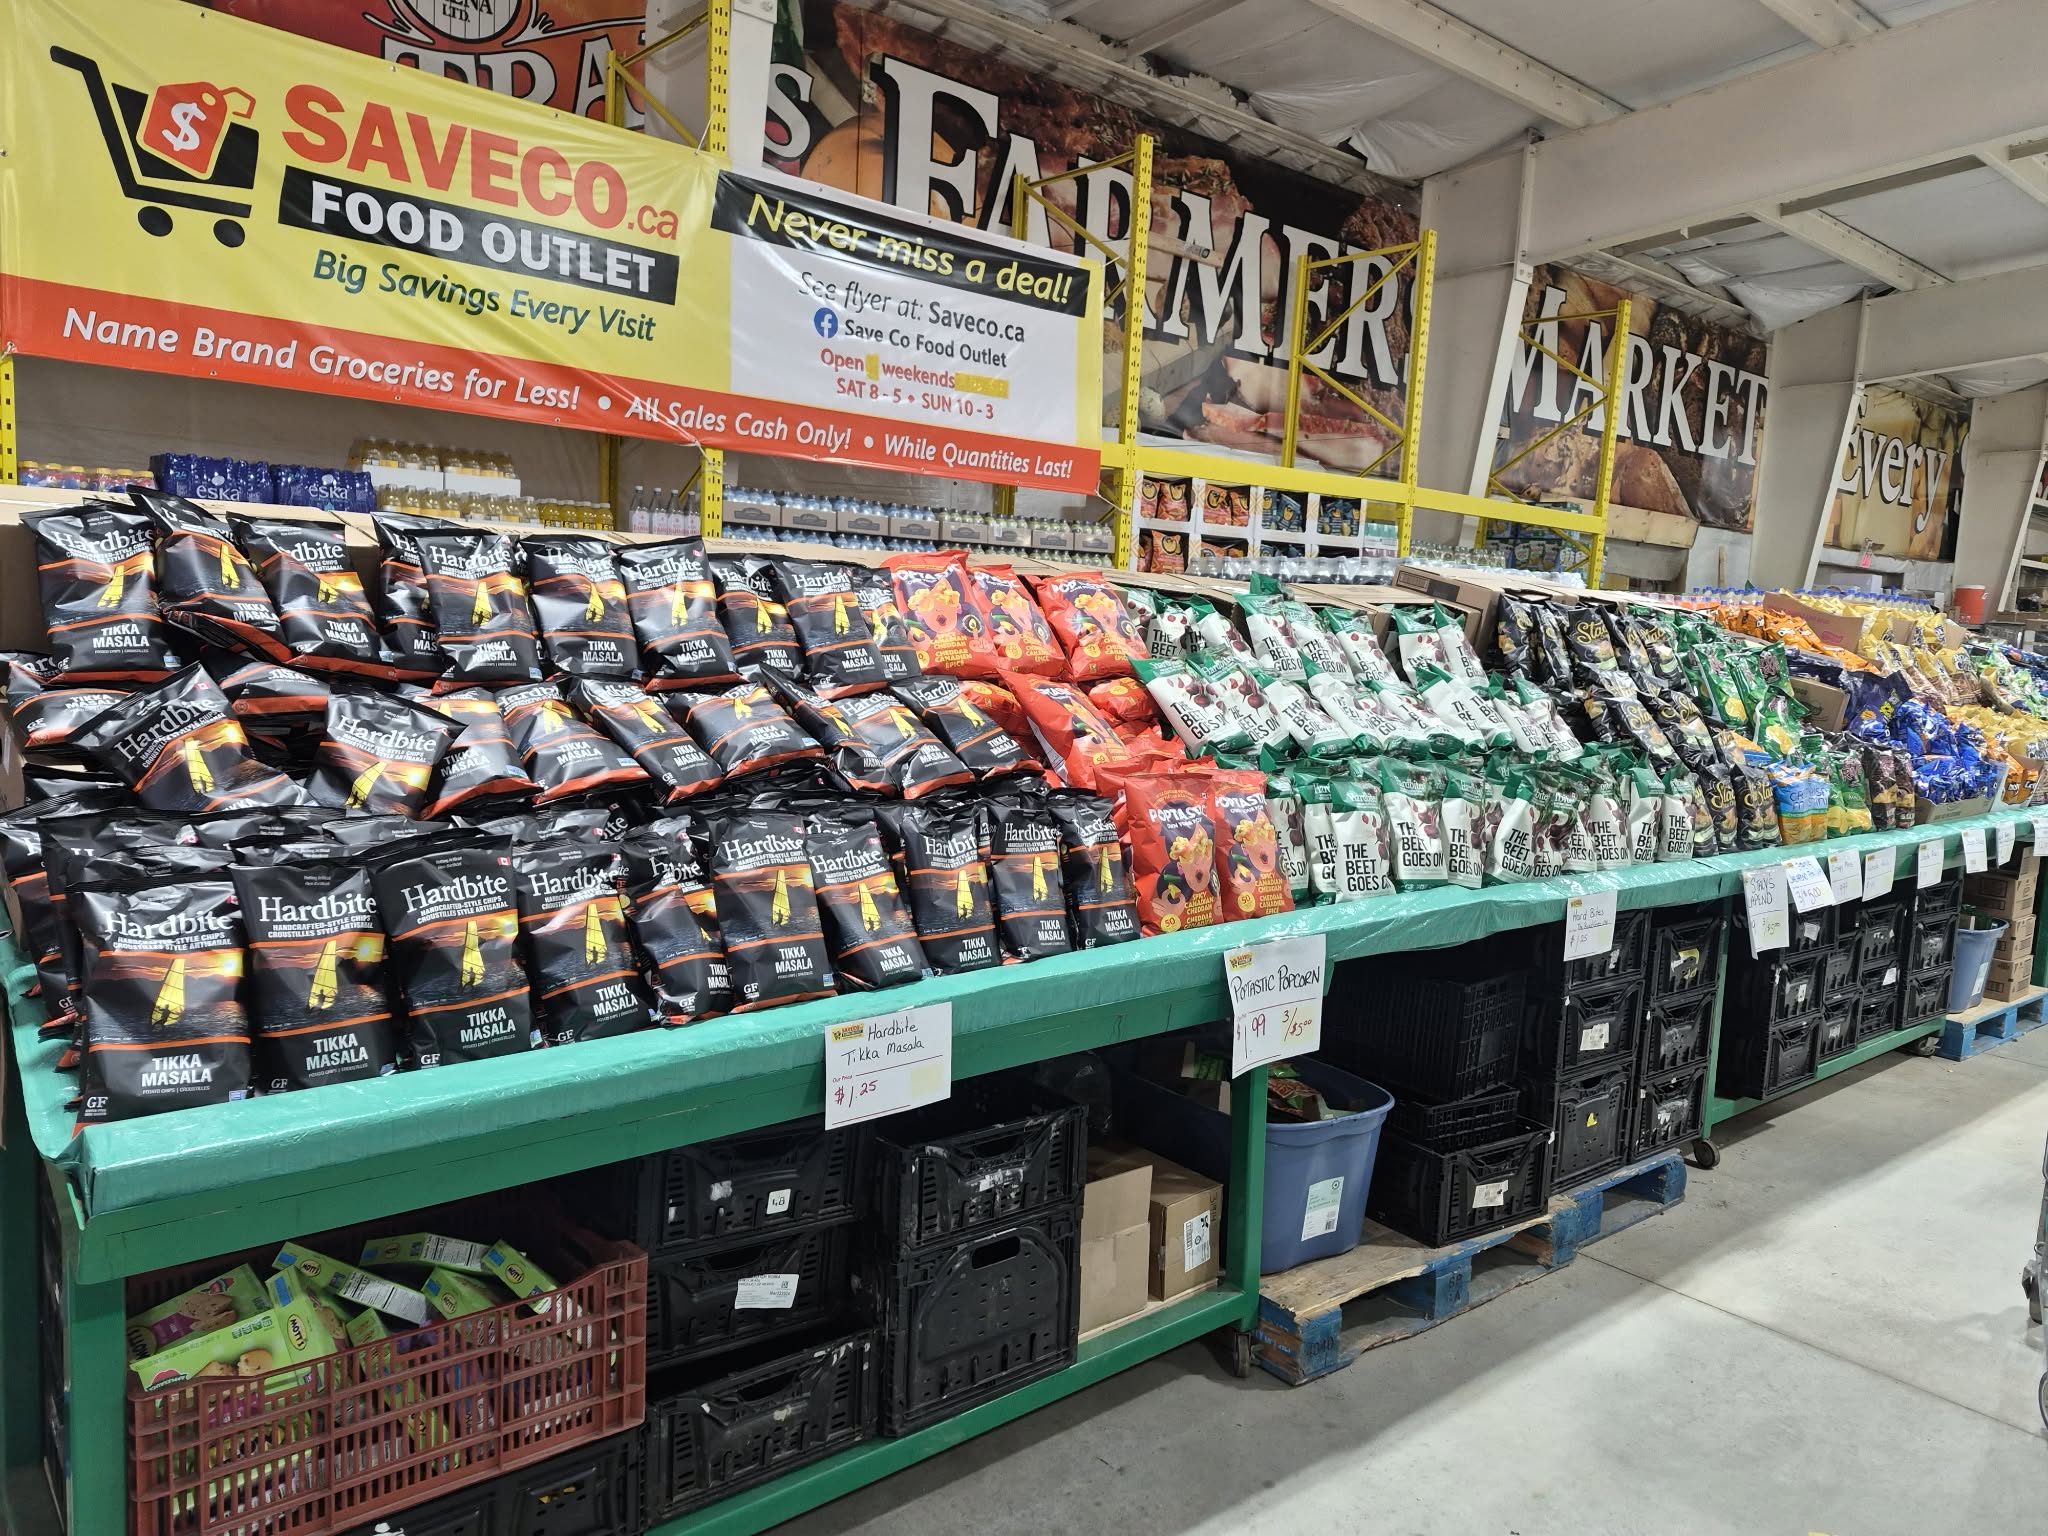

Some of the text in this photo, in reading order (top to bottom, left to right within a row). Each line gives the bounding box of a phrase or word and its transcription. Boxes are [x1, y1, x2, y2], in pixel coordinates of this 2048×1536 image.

[442, 3, 471, 23] LTD.
[311, 180, 655, 293] FOOD OUTLET
[747, 193, 1073, 304] Never miss a deal!
[314, 249, 656, 341] Big Savings Every Visit
[798, 271, 1025, 342] See flyer at: Saveco.ca
[845, 319, 1007, 368] Save Co Food Outlet
[820, 348, 955, 389] Open weekends
[1506, 285, 1769, 466] MARKET
[62, 308, 1072, 478] Name Brand Groceries for Less! All Sales Cash Only! While Quantities Last!
[837, 378, 993, 419] SAT 8 5 SUN 10 3
[51, 529, 155, 554] Hardbite
[101, 623, 140, 636] TIKKA
[1153, 629, 1173, 643] THE
[93, 636, 149, 648] MASALA
[588, 641, 617, 651] TIKKA
[680, 639, 708, 651] TIKKA
[1151, 642, 1177, 656] BEET
[583, 651, 624, 662] MASALA
[677, 648, 716, 663] MASALA
[765, 650, 787, 658] TIKKA
[844, 648, 868, 659] TIKKA
[842, 656, 874, 668] MASALA
[114, 698, 219, 762] Hardbite
[335, 715, 438, 753] Hardbite
[749, 729, 788, 746] MASALA
[751, 725, 778, 735] TIKKA
[672, 744, 697, 755] TIKKA
[987, 735, 1009, 748] TIKKA
[557, 748, 602, 766] MASALA
[674, 753, 706, 767] MASALA
[440, 755, 490, 777] MASALA
[1592, 821, 1611, 834] THE
[1669, 815, 1686, 828] THE
[1509, 828, 1529, 846] THE
[1594, 834, 1616, 847] BEET
[1669, 828, 1689, 841] BEET
[722, 835, 803, 862] Hardbite
[1343, 844, 1367, 859] THE
[1504, 842, 1530, 861] BEET
[1596, 848, 1619, 860] GOES
[1668, 841, 1686, 853] GOES
[809, 849, 884, 874] Hardbite
[1346, 859, 1376, 875] BEET
[1403, 853, 1443, 867] GOES ON
[1449, 859, 1483, 876] GOES ON
[1502, 856, 1526, 875] GOES
[1347, 876, 1380, 892] GOES
[400, 875, 510, 913] Hardbite
[1242, 895, 1251, 904] 50
[258, 893, 376, 922] Hardbite
[1106, 909, 1128, 921] TIKKA
[1573, 909, 1587, 922] Hard
[102, 910, 233, 939] Hardbite
[1039, 920, 1061, 930] TIKKA
[1105, 920, 1133, 931] MASALA
[1165, 919, 1175, 927] 50
[962, 937, 986, 948] TIKKA
[1038, 930, 1065, 941] MASALA
[1084, 938, 1096, 947] GF
[779, 946, 806, 960] TIKKA
[879, 946, 905, 959] TIKKA
[959, 947, 992, 963] MASALA
[775, 958, 813, 974] MASALA
[880, 954, 913, 972] MASALA
[1278, 965, 1320, 991] POPCORN
[596, 983, 630, 1001] TIKKA
[743, 983, 759, 993] GF
[593, 996, 638, 1017] MASALA
[467, 1007, 507, 1027] TIKKA
[460, 1019, 516, 1043] MASALA
[557, 1030, 574, 1042] GF
[868, 1016, 918, 1041] Hardbite
[313, 1033, 358, 1053] TIKKA
[841, 1036, 924, 1066] Tikka Masala
[152, 1054, 201, 1071] TIKKA
[306, 1047, 368, 1071] MASALA
[421, 1054, 440, 1065] GF
[142, 1069, 213, 1087] MASALA
[271, 1079, 288, 1089] GF
[86, 1097, 108, 1108] GF
